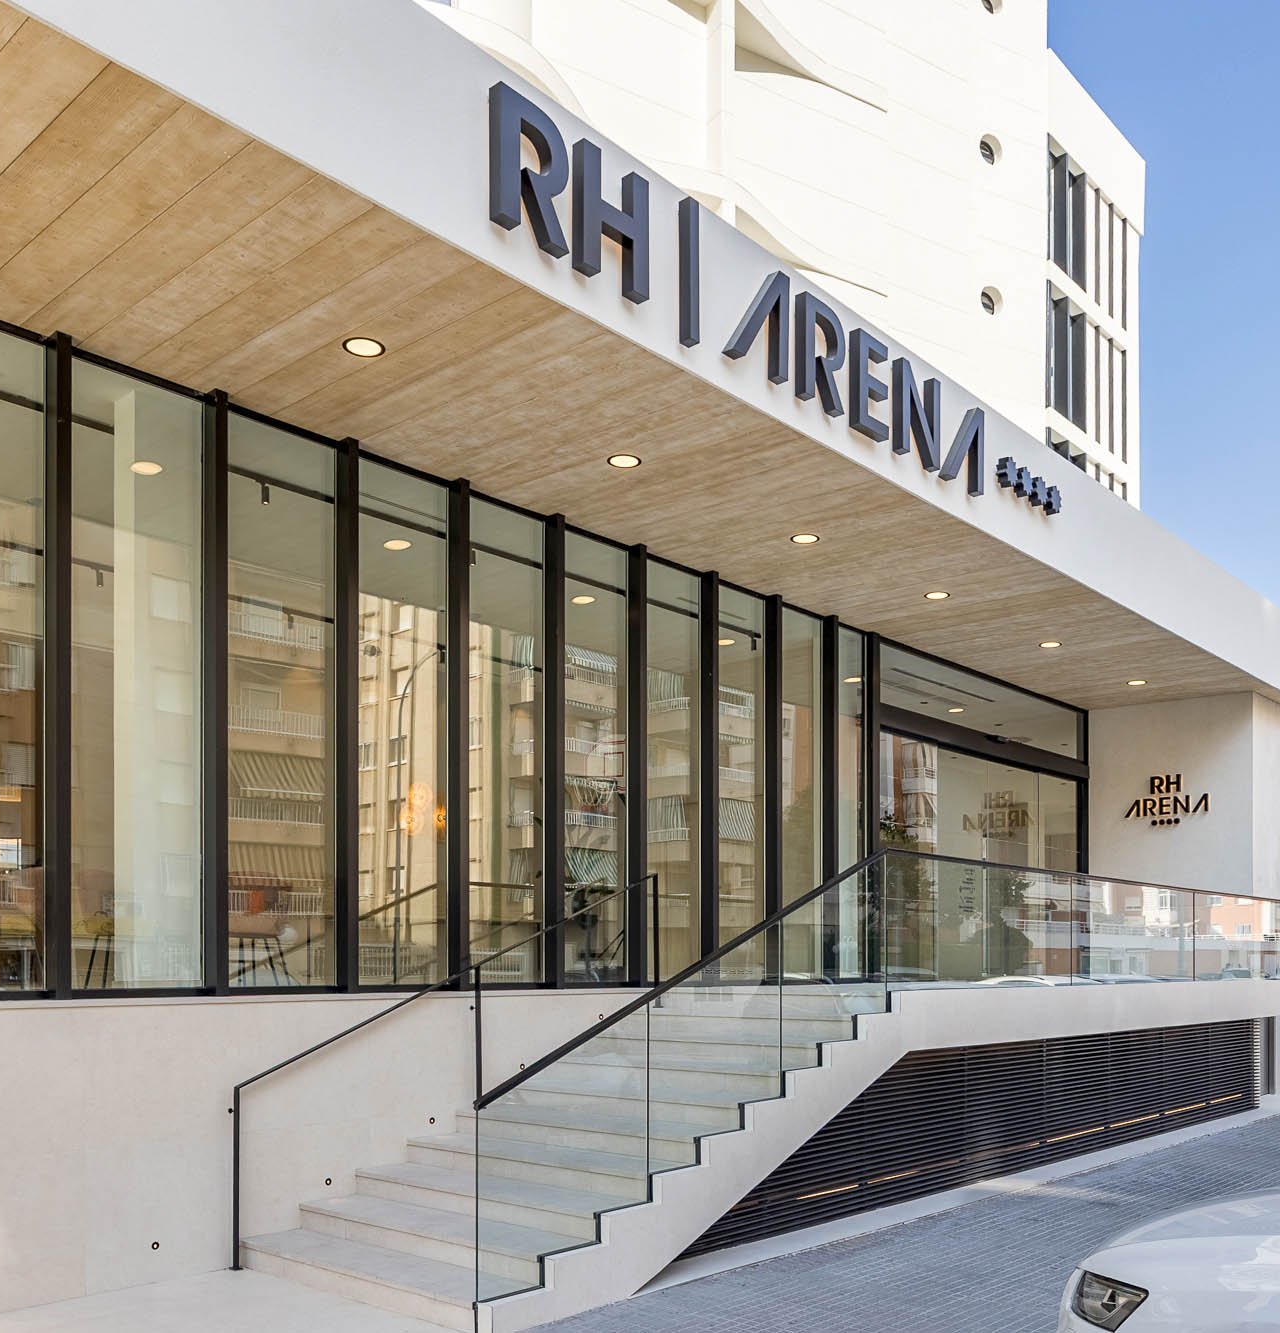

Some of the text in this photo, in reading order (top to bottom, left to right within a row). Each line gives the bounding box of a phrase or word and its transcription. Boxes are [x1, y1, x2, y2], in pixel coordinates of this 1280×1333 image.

[488, 80, 986, 498] RH ARENA
[1148, 773, 1183, 796] RH
[1124, 792, 1210, 819] ARENA
